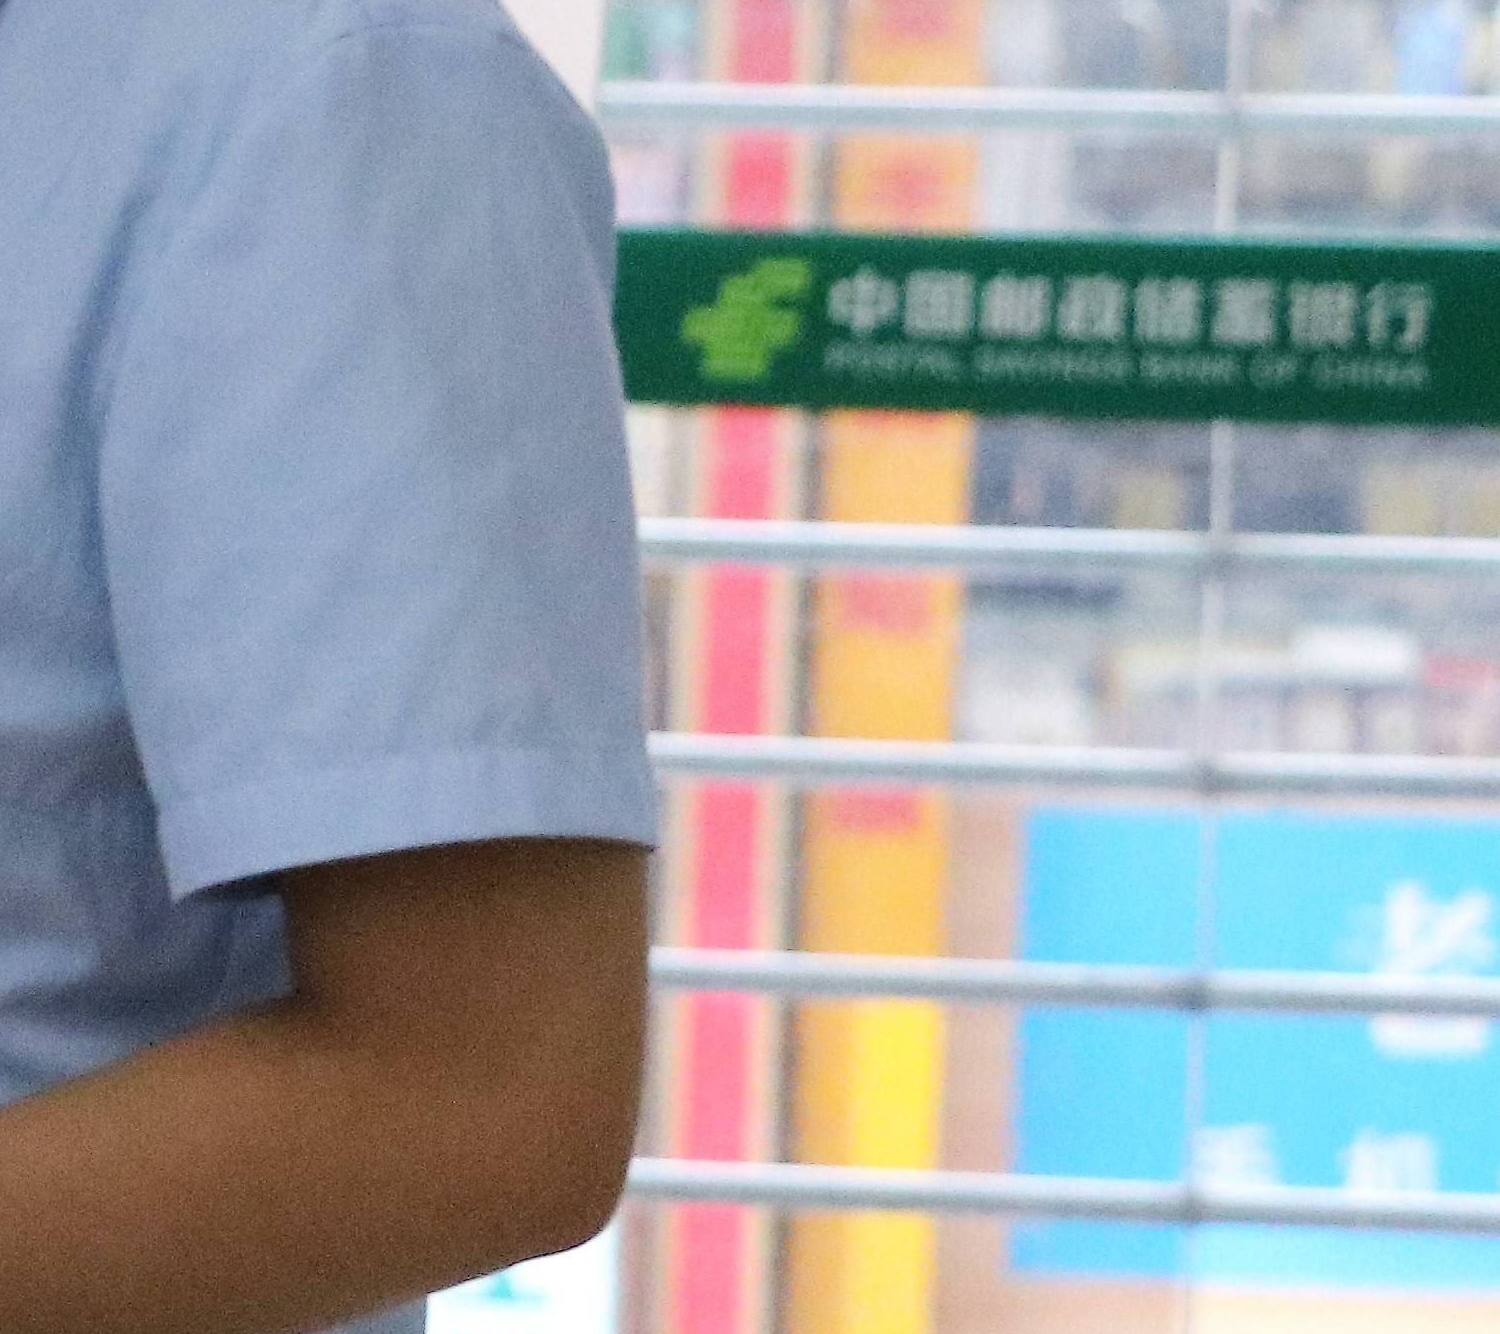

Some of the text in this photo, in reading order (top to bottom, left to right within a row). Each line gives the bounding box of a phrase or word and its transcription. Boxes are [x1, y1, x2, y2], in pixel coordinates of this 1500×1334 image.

[826, 265, 1432, 353] 中国邮政储蓄银行
